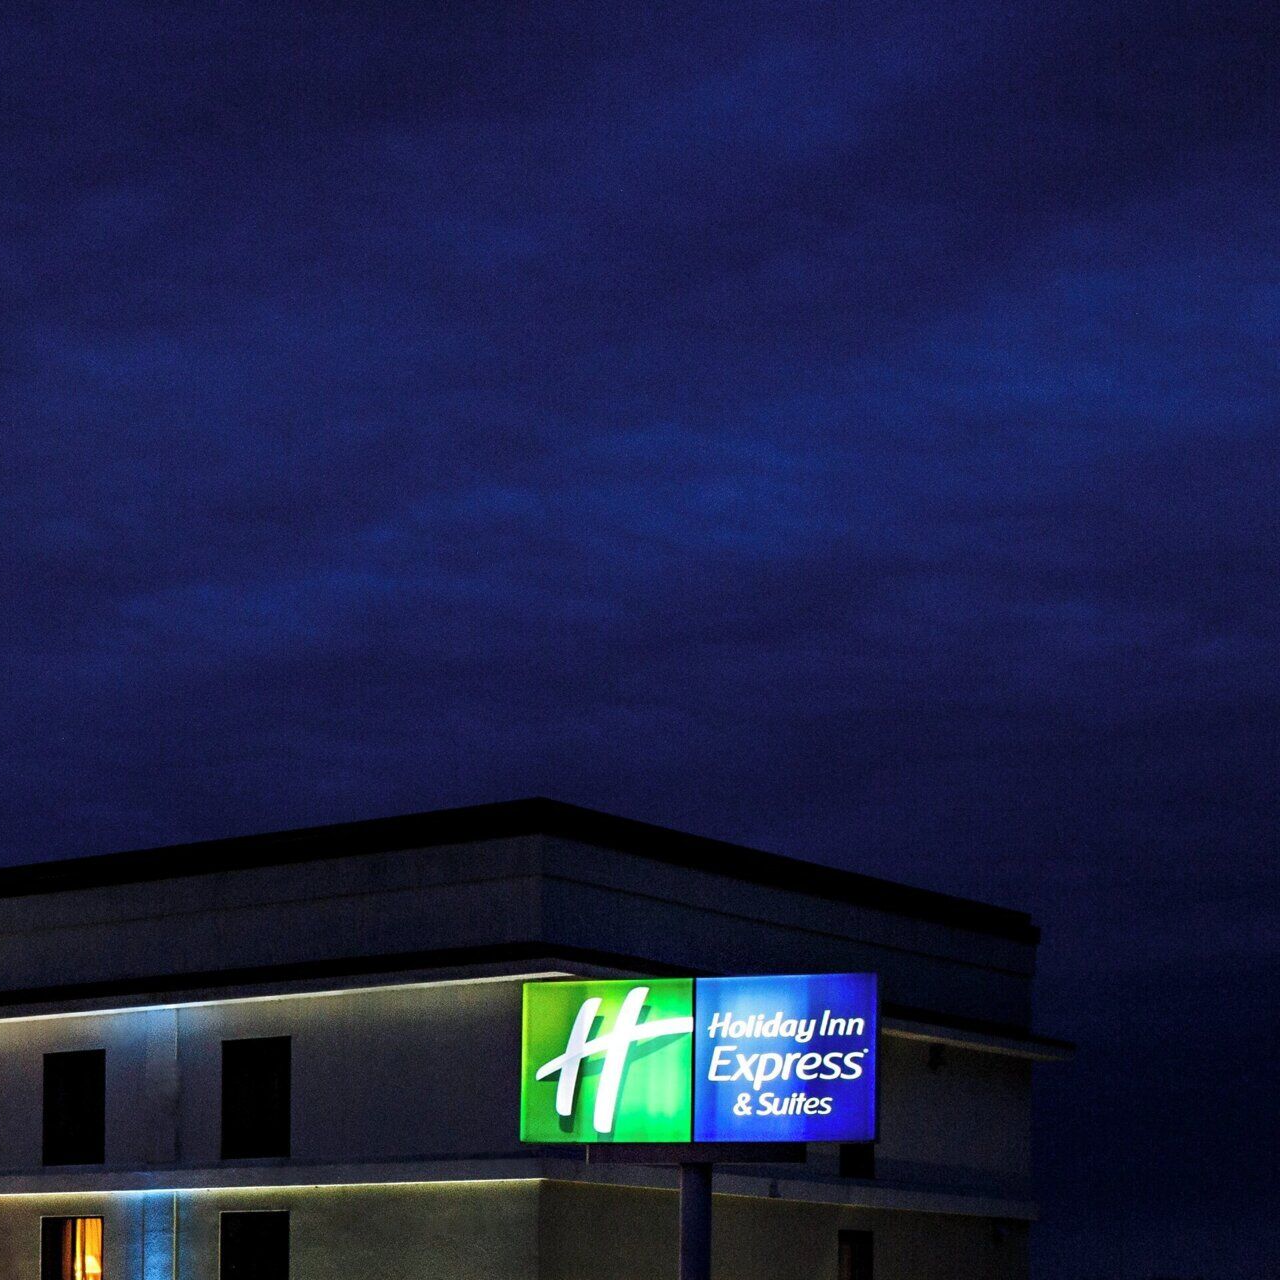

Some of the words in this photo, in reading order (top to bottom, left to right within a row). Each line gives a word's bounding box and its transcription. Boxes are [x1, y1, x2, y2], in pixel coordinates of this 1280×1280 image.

[708, 1012, 815, 1043] Holiday
[820, 1009, 865, 1037] Inn
[536, 987, 694, 1133] H
[707, 1045, 864, 1091] Express
[733, 1094, 752, 1116] &
[756, 1092, 833, 1116] Suites
